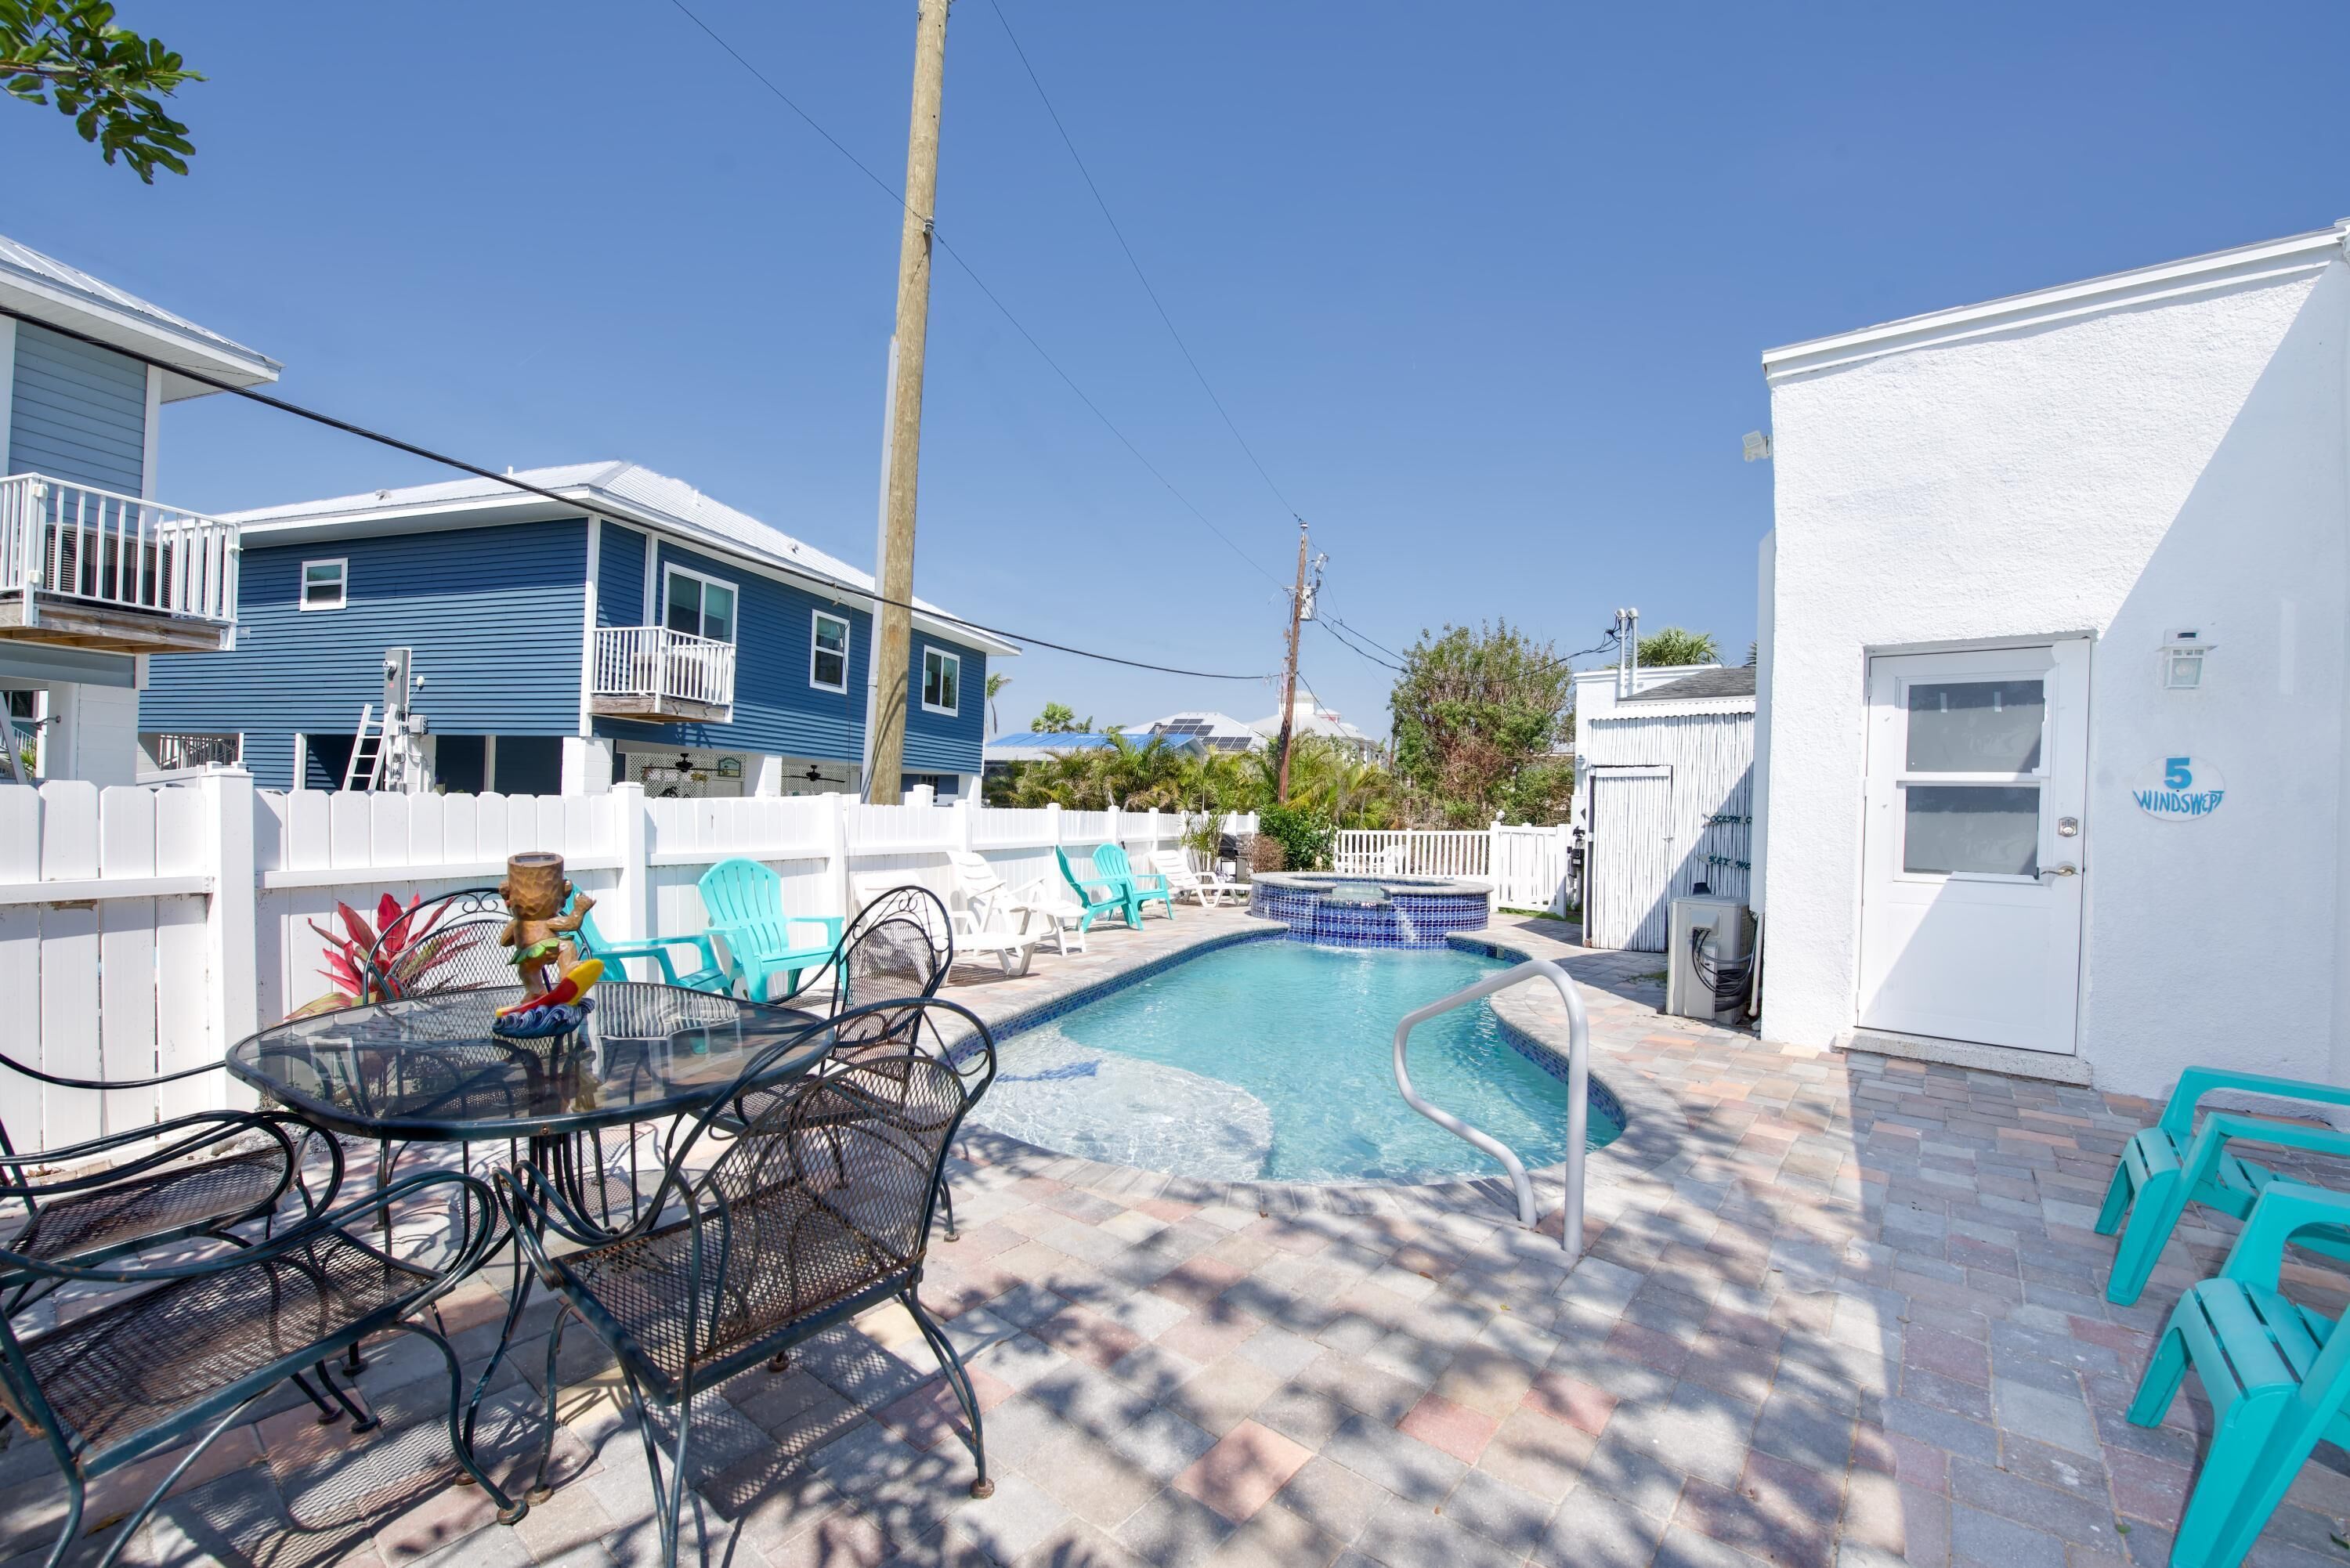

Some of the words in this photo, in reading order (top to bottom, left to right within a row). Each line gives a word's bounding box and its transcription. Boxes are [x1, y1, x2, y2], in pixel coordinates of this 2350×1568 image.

[2164, 757, 2193, 789] 5
[2132, 789, 2225, 815] WINDSWEPT
[1708, 855, 1730, 865] KEY
